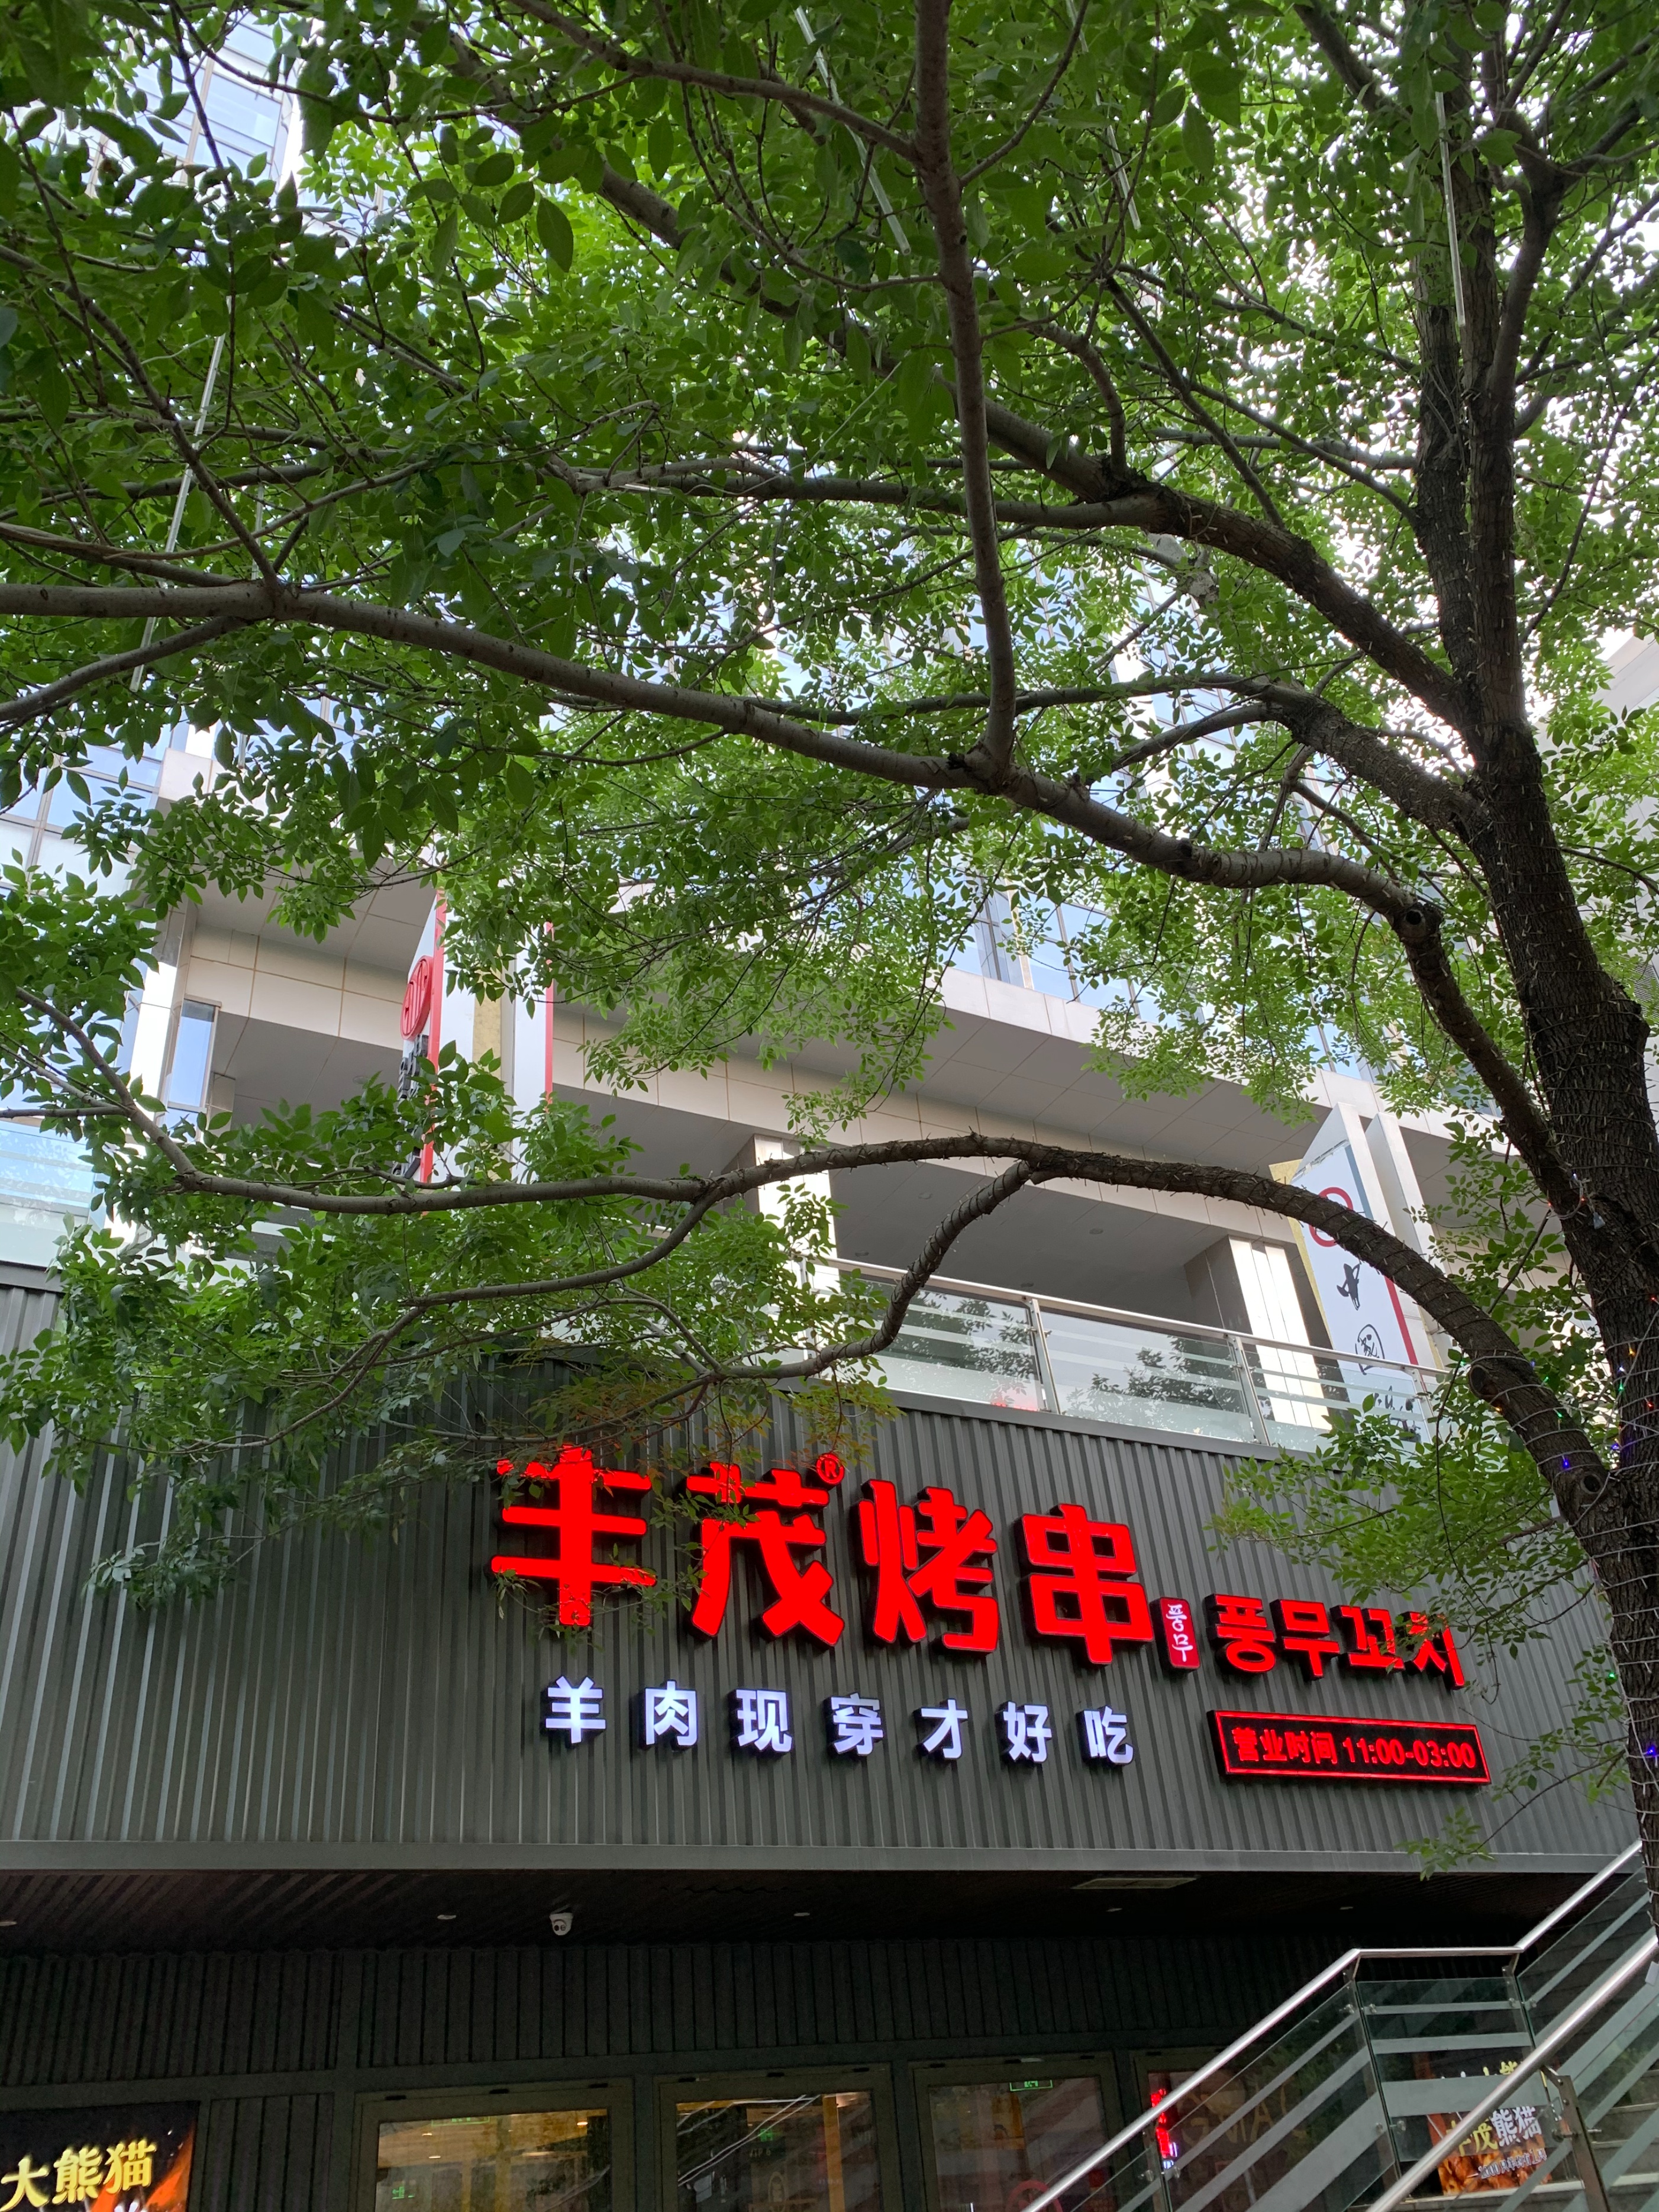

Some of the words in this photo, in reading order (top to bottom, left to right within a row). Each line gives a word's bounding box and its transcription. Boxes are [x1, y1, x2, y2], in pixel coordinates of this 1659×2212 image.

[492, 1445, 1154, 1663] 丰茂烤串
[1216, 1594, 1465, 1687] 풍무꼬치
[546, 1675, 1134, 1765] 羊肉现穿才好吃
[1232, 1727, 1338, 1765] 营业时间
[1342, 1737, 1476, 1768] 11:00-03:00
[1, 2139, 157, 2211] 大熊猫
